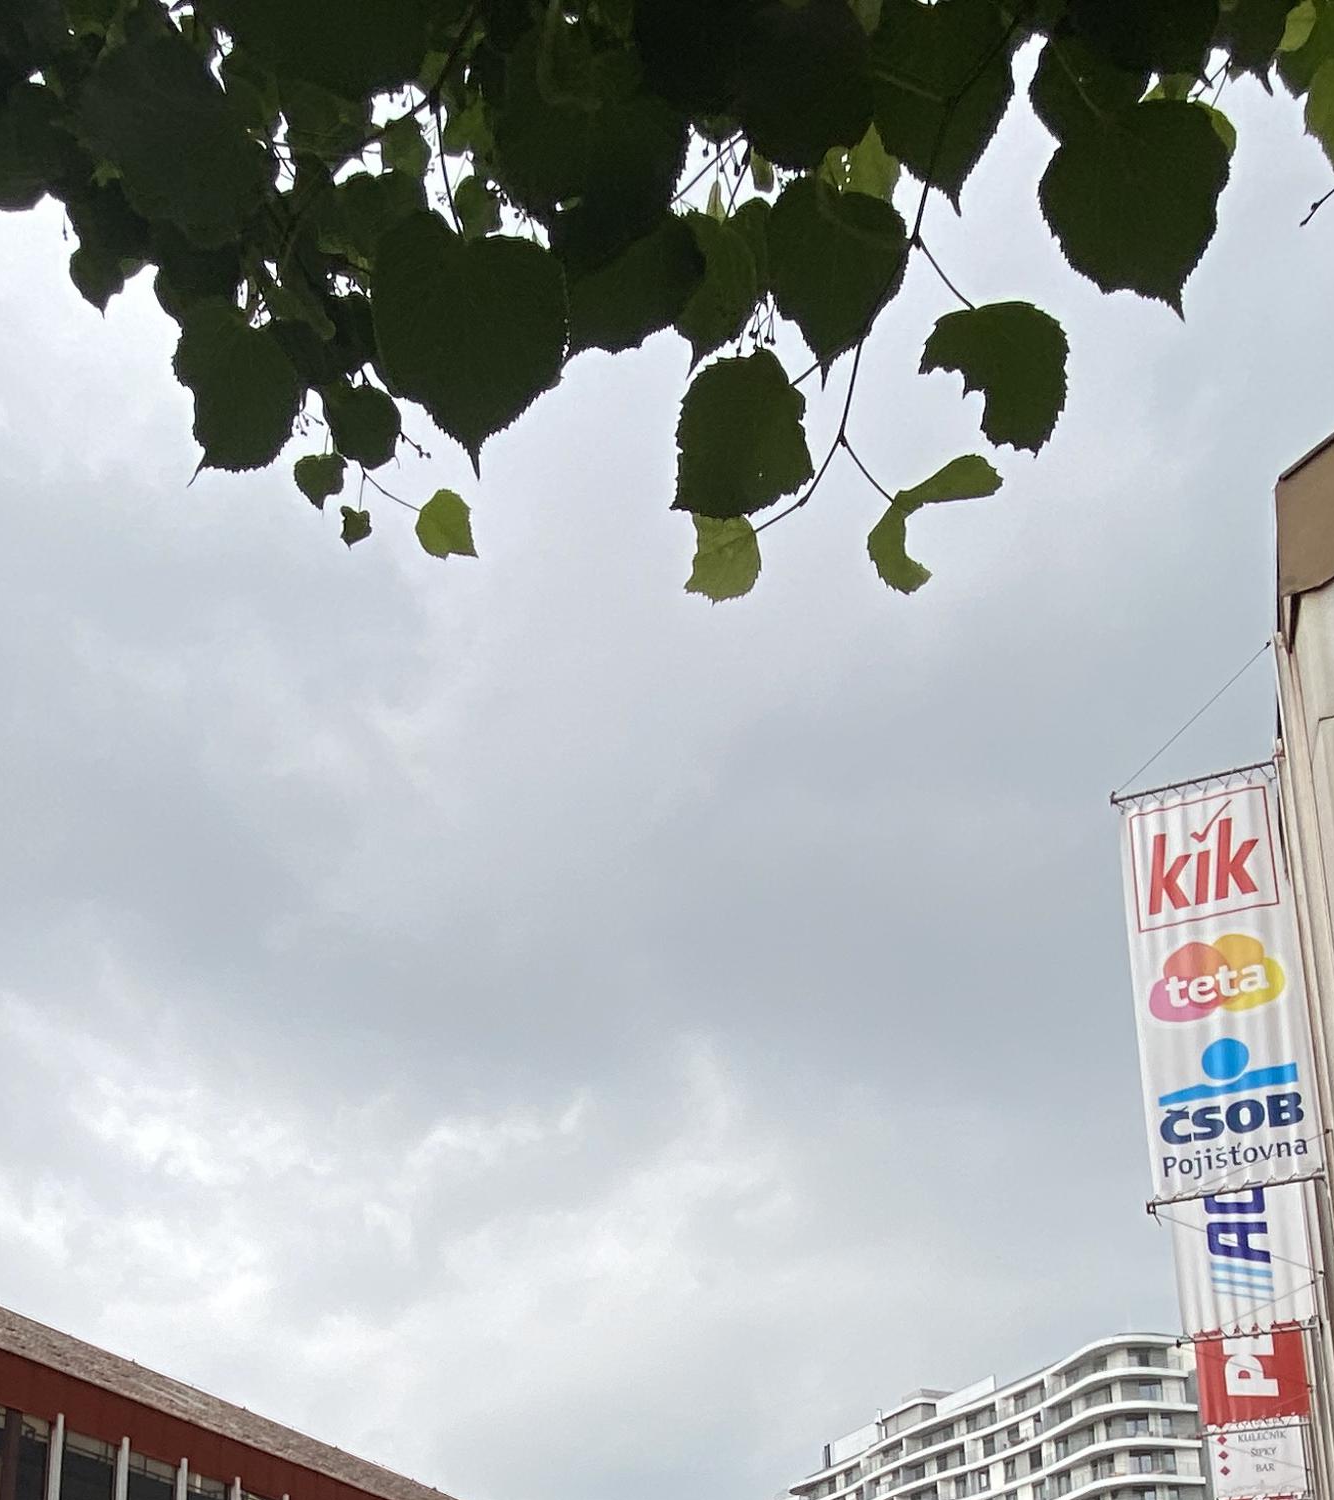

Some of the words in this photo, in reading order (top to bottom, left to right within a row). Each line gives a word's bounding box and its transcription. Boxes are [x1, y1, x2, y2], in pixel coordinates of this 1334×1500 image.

[1165, 964, 1268, 1008] teta
[1159, 1090, 1305, 1145] ČSOB
[1162, 1136, 1309, 1179] Pojišťovna
[1255, 1463, 1275, 1472] BAR
